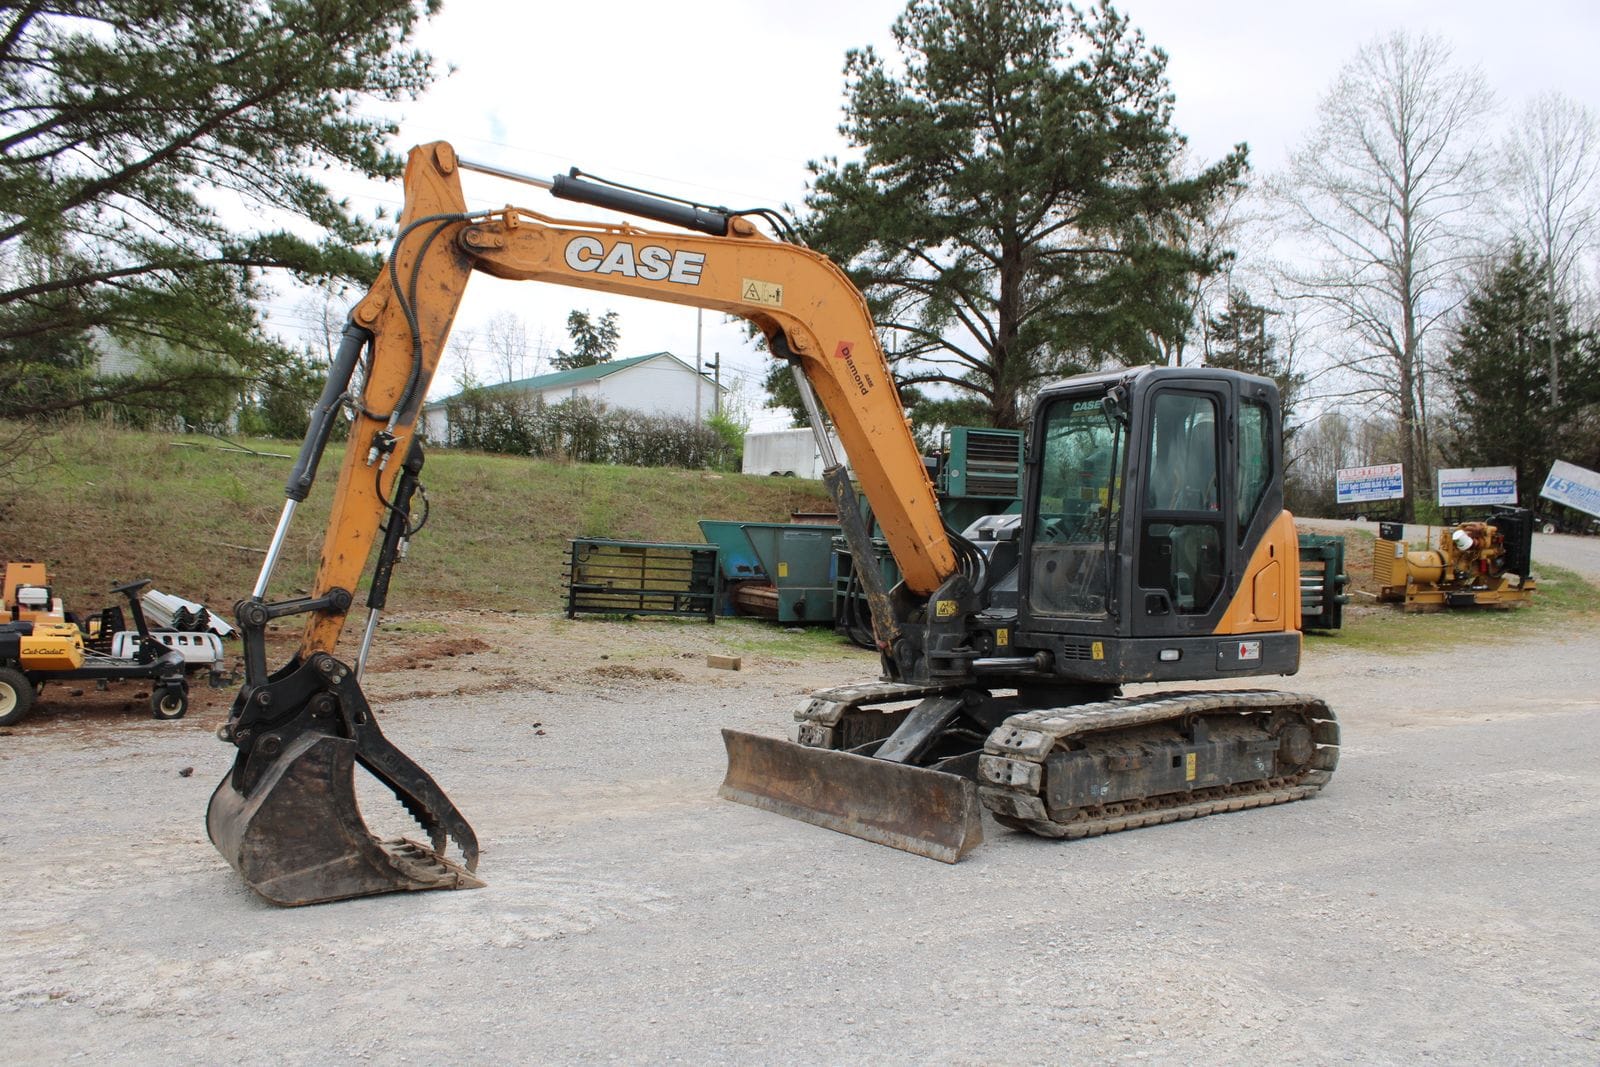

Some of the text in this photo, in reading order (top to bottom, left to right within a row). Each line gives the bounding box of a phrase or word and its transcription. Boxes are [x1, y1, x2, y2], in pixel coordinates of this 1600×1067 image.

[564, 236, 706, 285] CASE
[841, 346, 869, 396] Diamond
[1072, 400, 1101, 411] CASE
